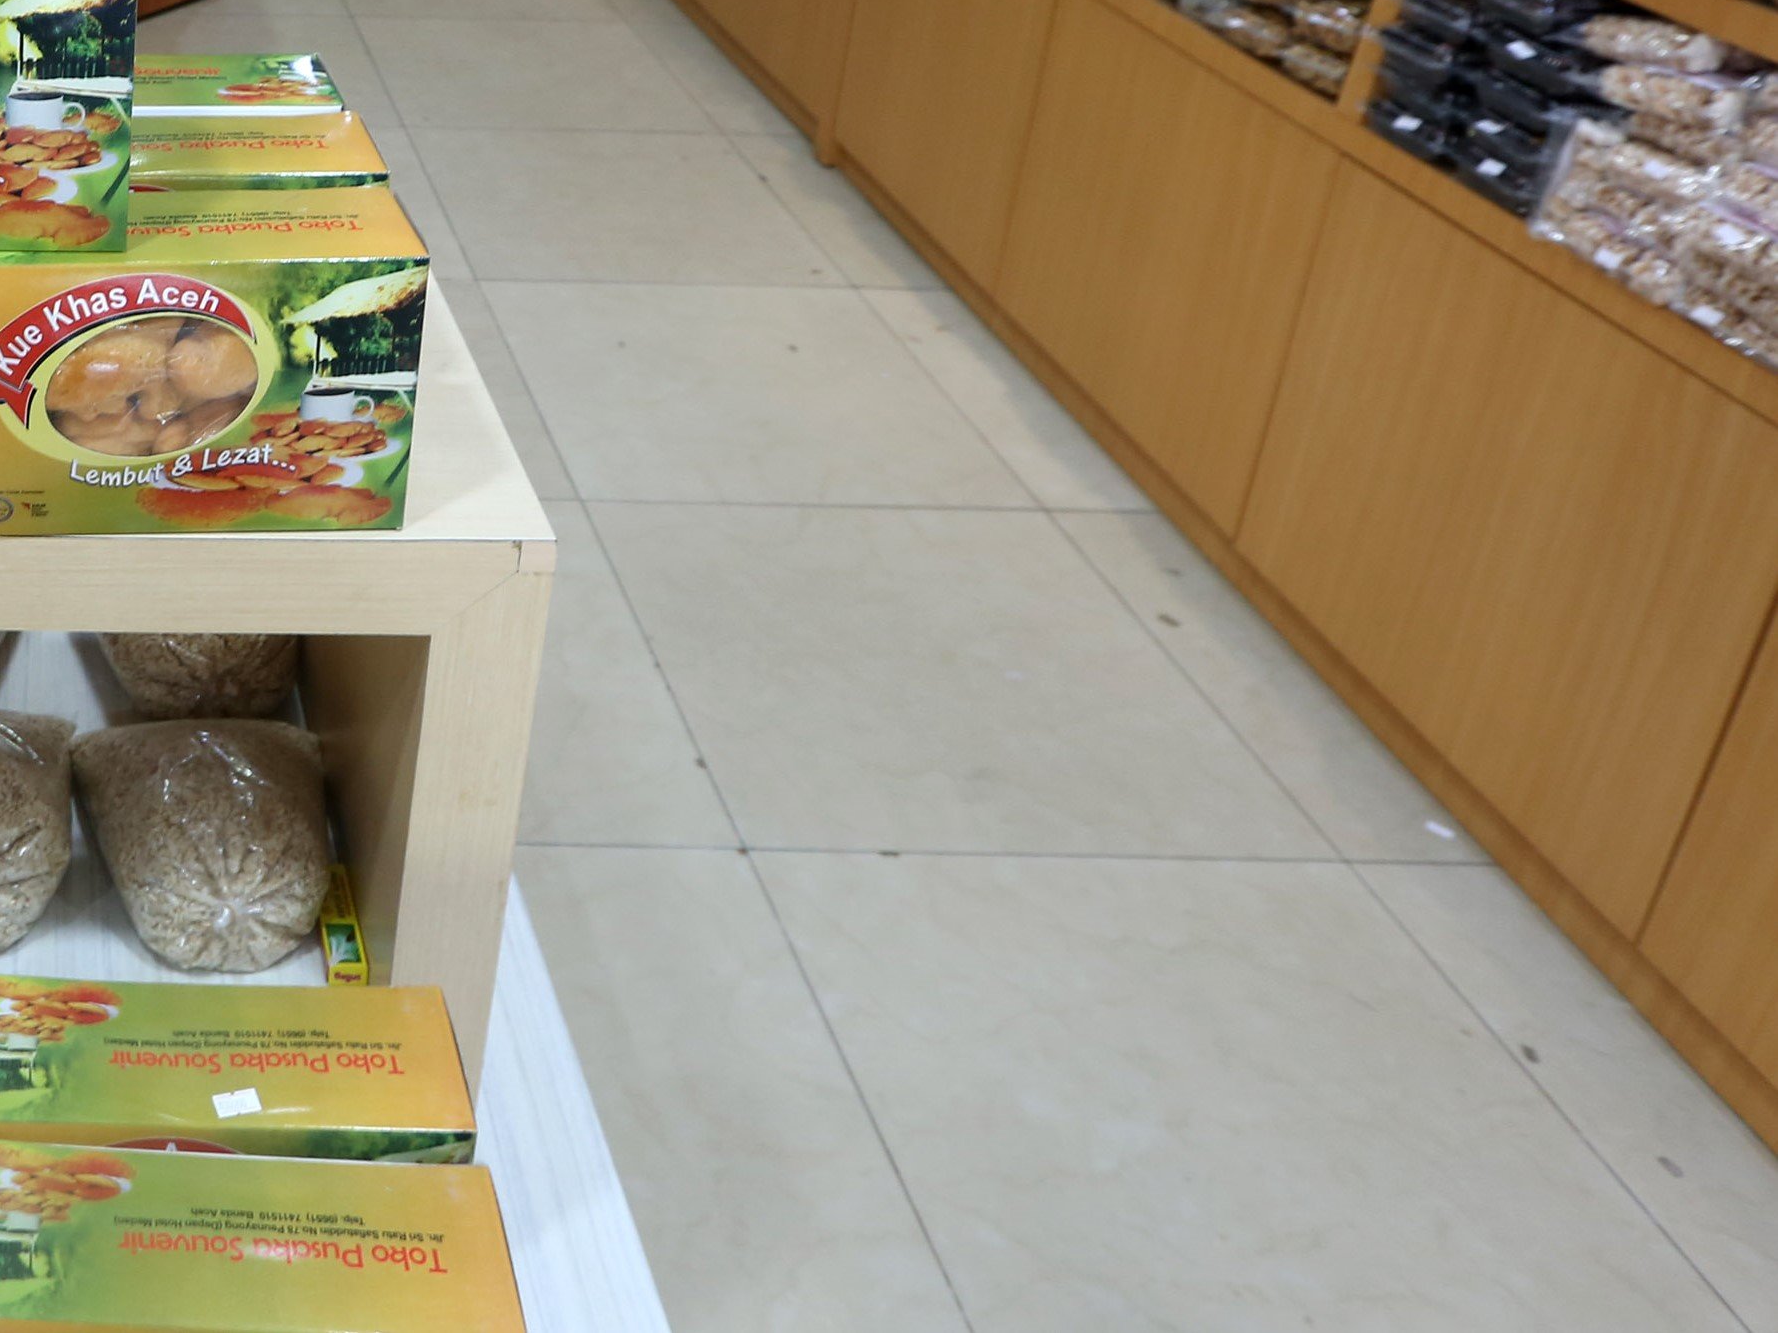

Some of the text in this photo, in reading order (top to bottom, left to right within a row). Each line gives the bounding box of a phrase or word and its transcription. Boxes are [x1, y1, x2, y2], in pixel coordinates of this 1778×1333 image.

[198, 222, 292, 233] Pusaka
[299, 220, 363, 231] Toko
[126, 226, 191, 237] Souv
[42, 285, 125, 326] Khas
[136, 277, 220, 313] Aceh
[69, 443, 296, 488] Lembut & Lezat...
[108, 1050, 405, 1076] Toko Pusaka Souvenir
[190, 1207, 218, 1217] Aceh
[220, 1209, 254, 1219] Banda
[155, 1219, 181, 1228] Hotel
[224, 1220, 284, 1233] Peunayong
[382, 1230, 407, 1240] Ratu
[409, 1232, 424, 1242] Sri
[118, 1231, 448, 1275] Toko Pusaka Souvenir
